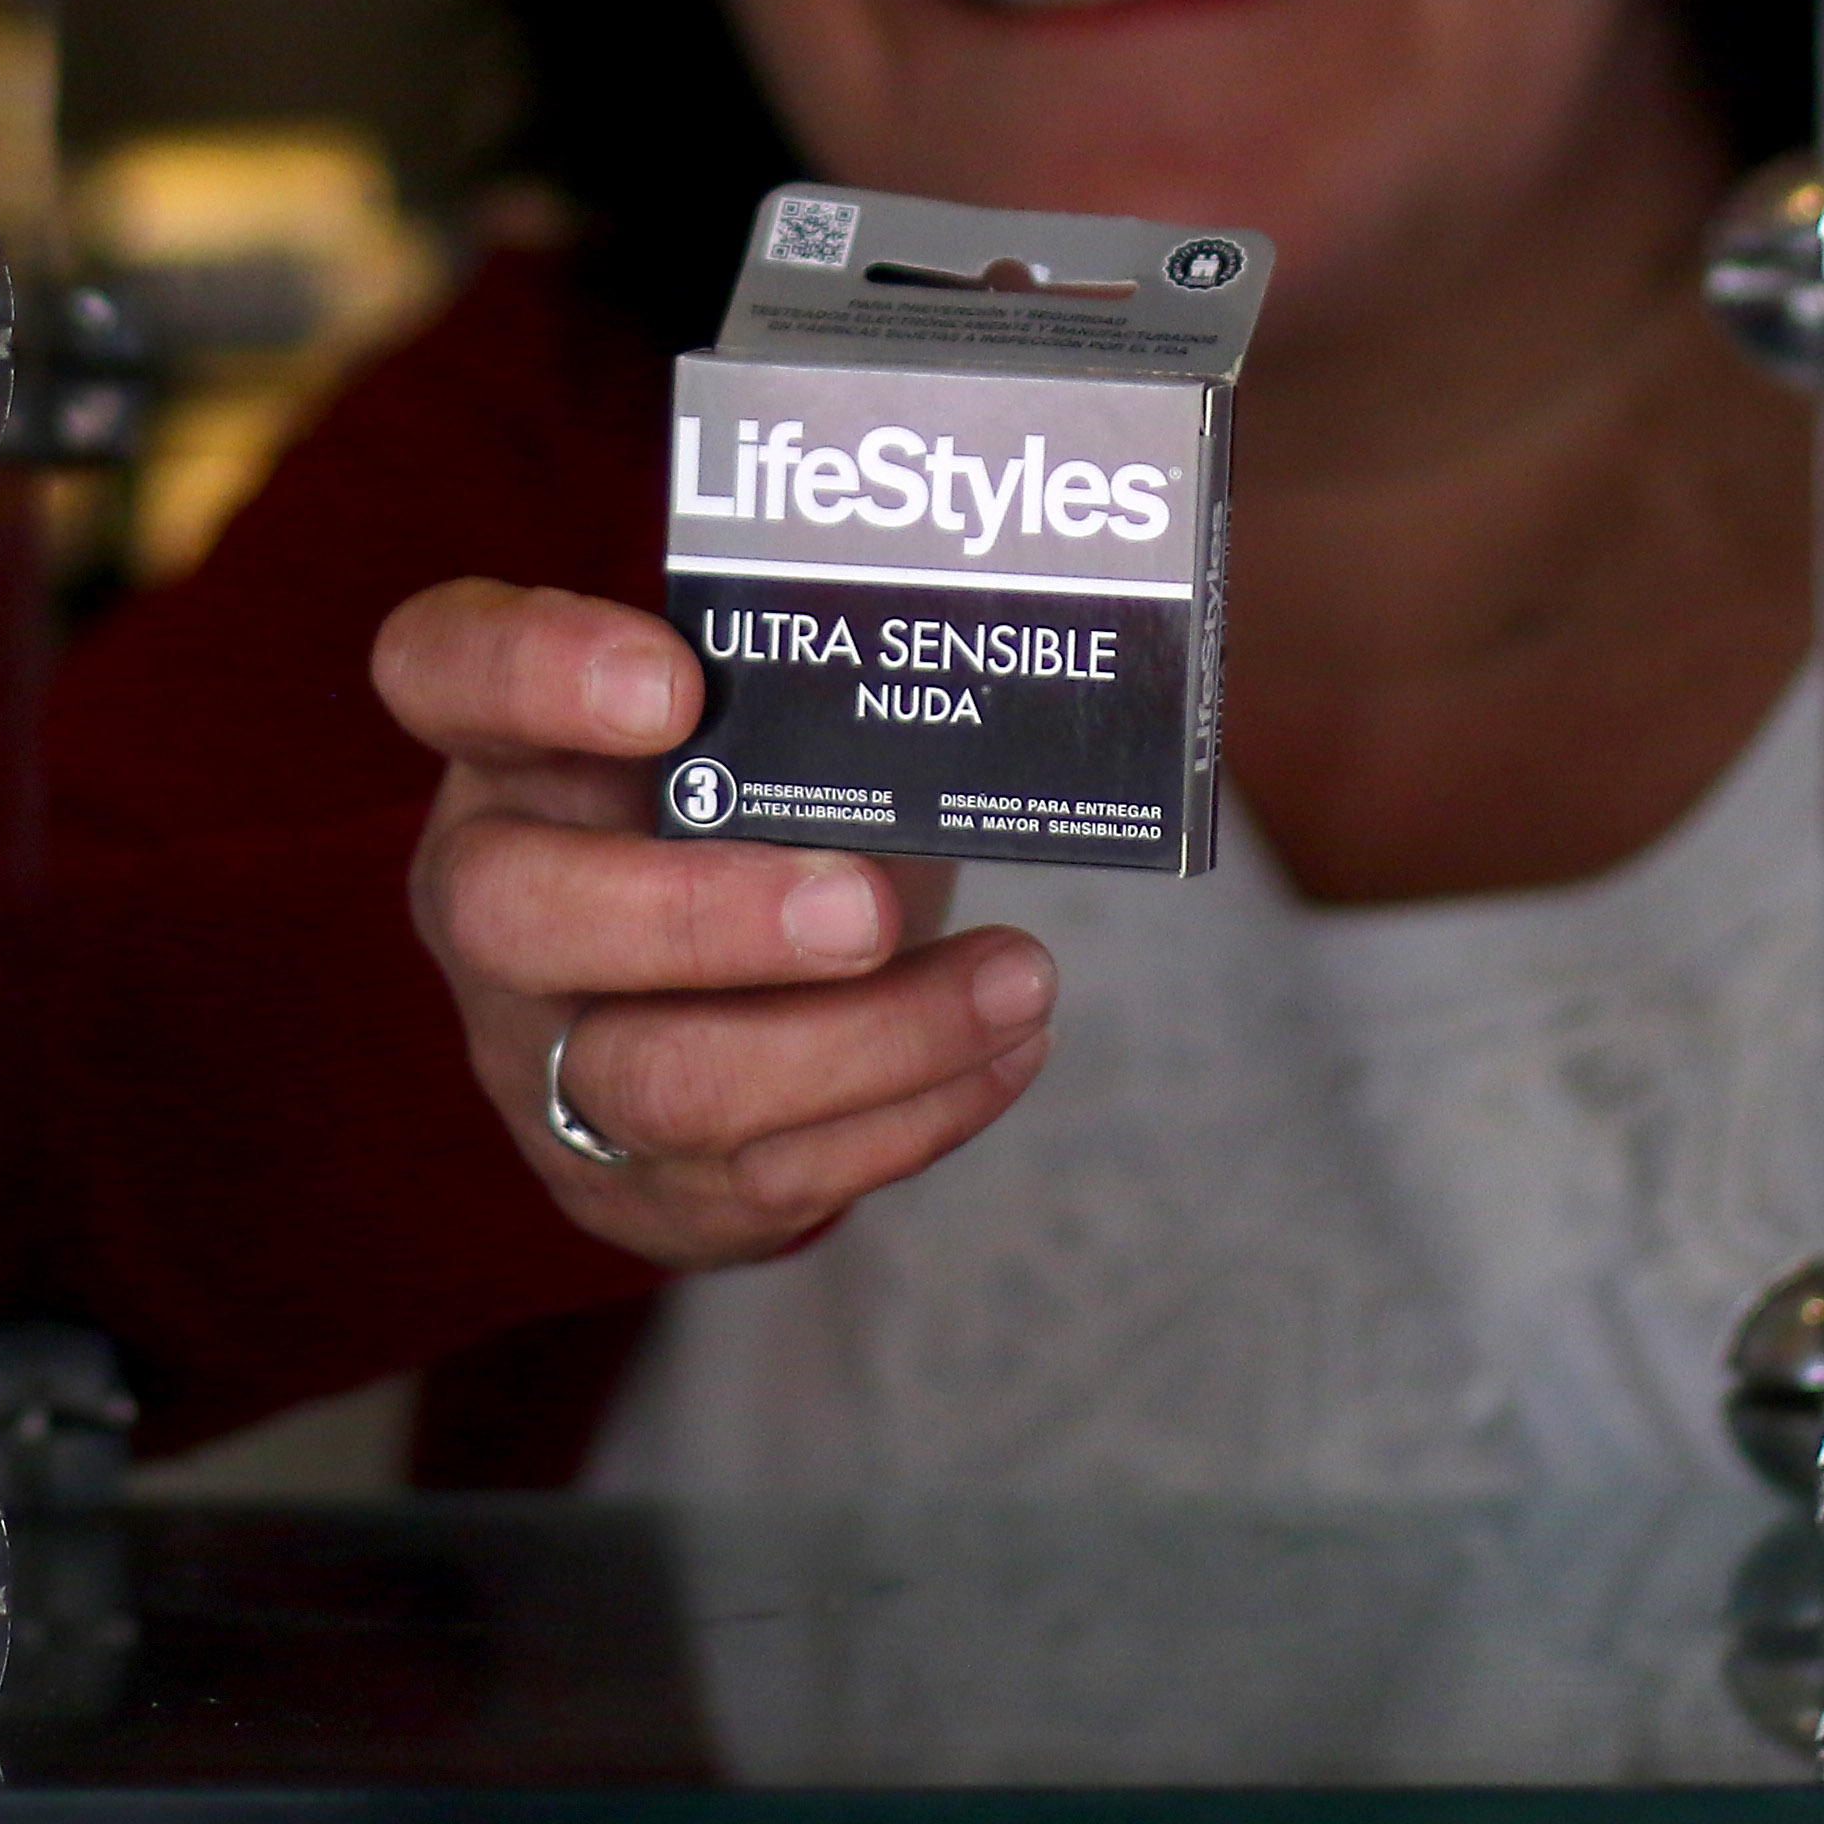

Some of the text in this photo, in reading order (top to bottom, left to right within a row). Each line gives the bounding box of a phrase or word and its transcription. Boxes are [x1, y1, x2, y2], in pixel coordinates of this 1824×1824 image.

[675, 414, 1171, 556] LifeStyles
[702, 607, 1118, 681] ULTRA SENSIBLE
[856, 682, 984, 725] NUDA
[687, 765, 719, 821] 3
[741, 782, 894, 804] PRESERVATIVOS DE
[741, 798, 898, 823] LÁTEX LUBRICADOS
[939, 792, 1164, 820] DISEÑADO PARA ENTREGAR
[939, 813, 1164, 840] UNA MAYOR SENSIBILIDAD
